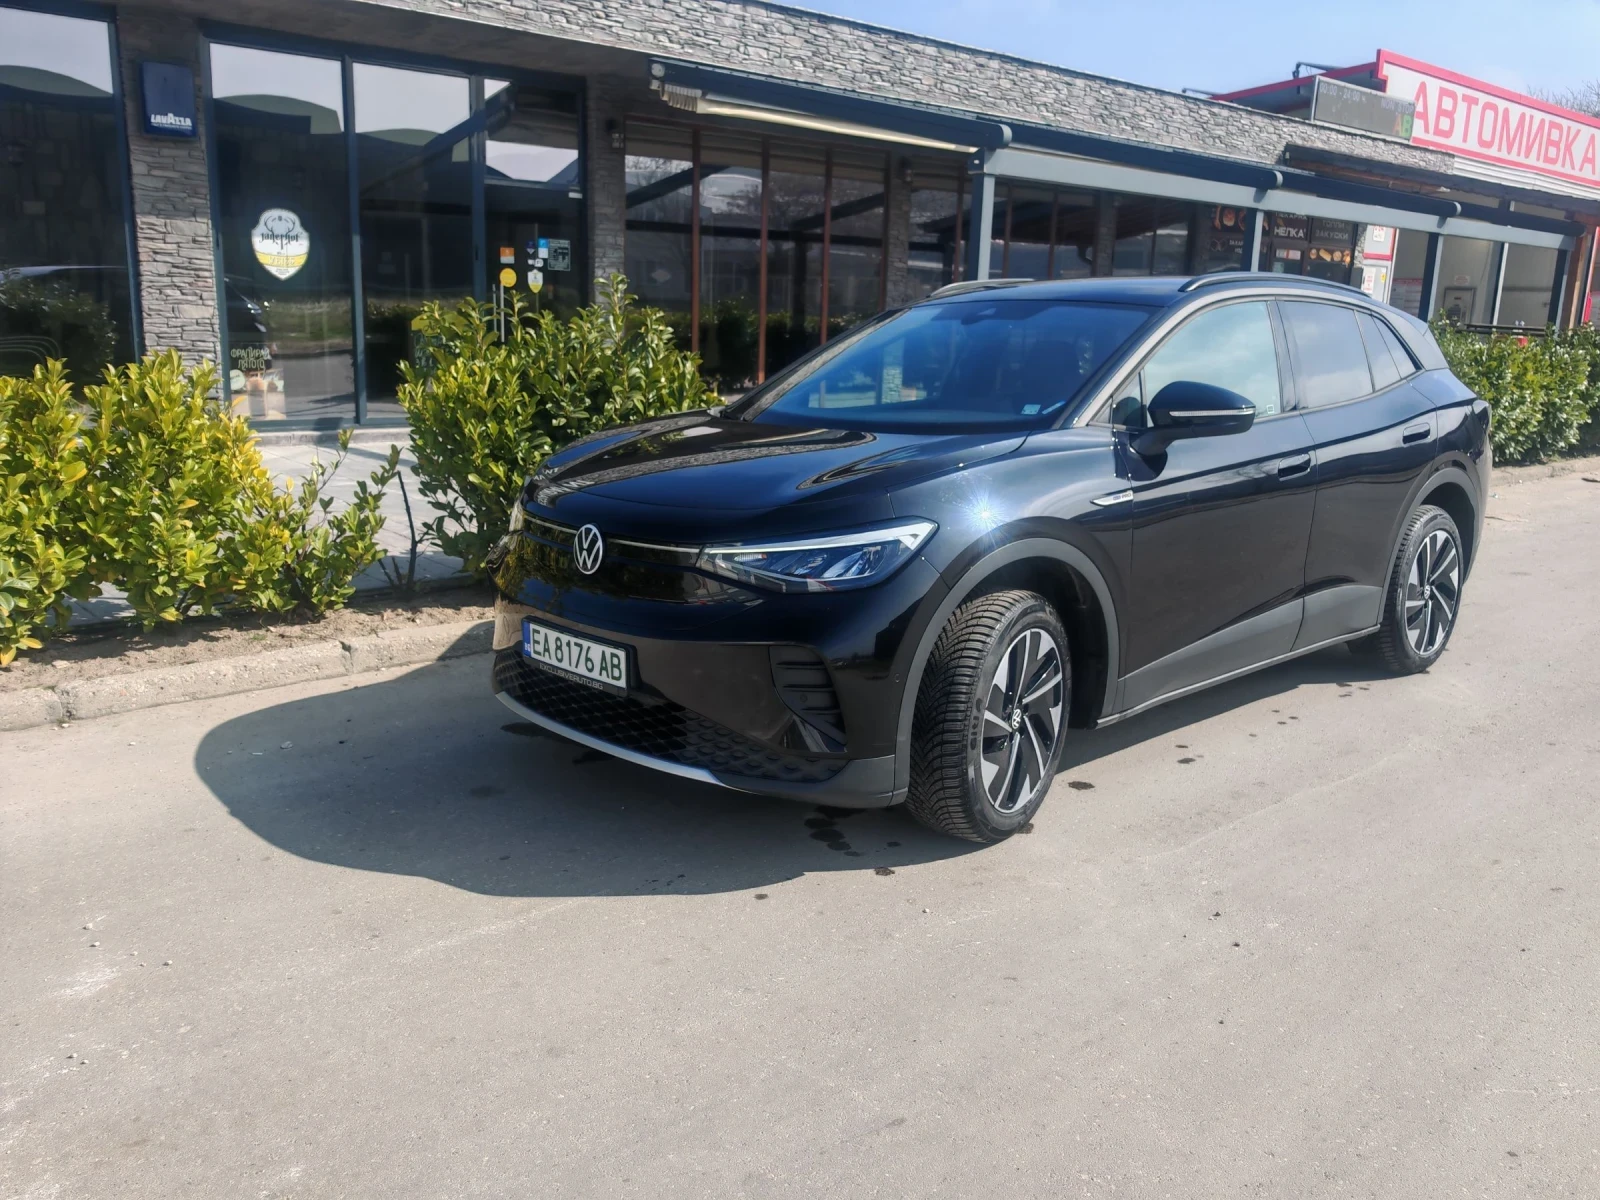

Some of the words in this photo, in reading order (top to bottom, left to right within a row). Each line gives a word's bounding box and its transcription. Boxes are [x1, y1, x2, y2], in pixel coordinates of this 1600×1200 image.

[150, 112, 192, 126] LAVAZZA
[1414, 81, 1596, 176] АВТОМИВКА
[532, 628, 551, 661] EA
[554, 636, 595, 673] 8176
[599, 649, 623, 681] AB
